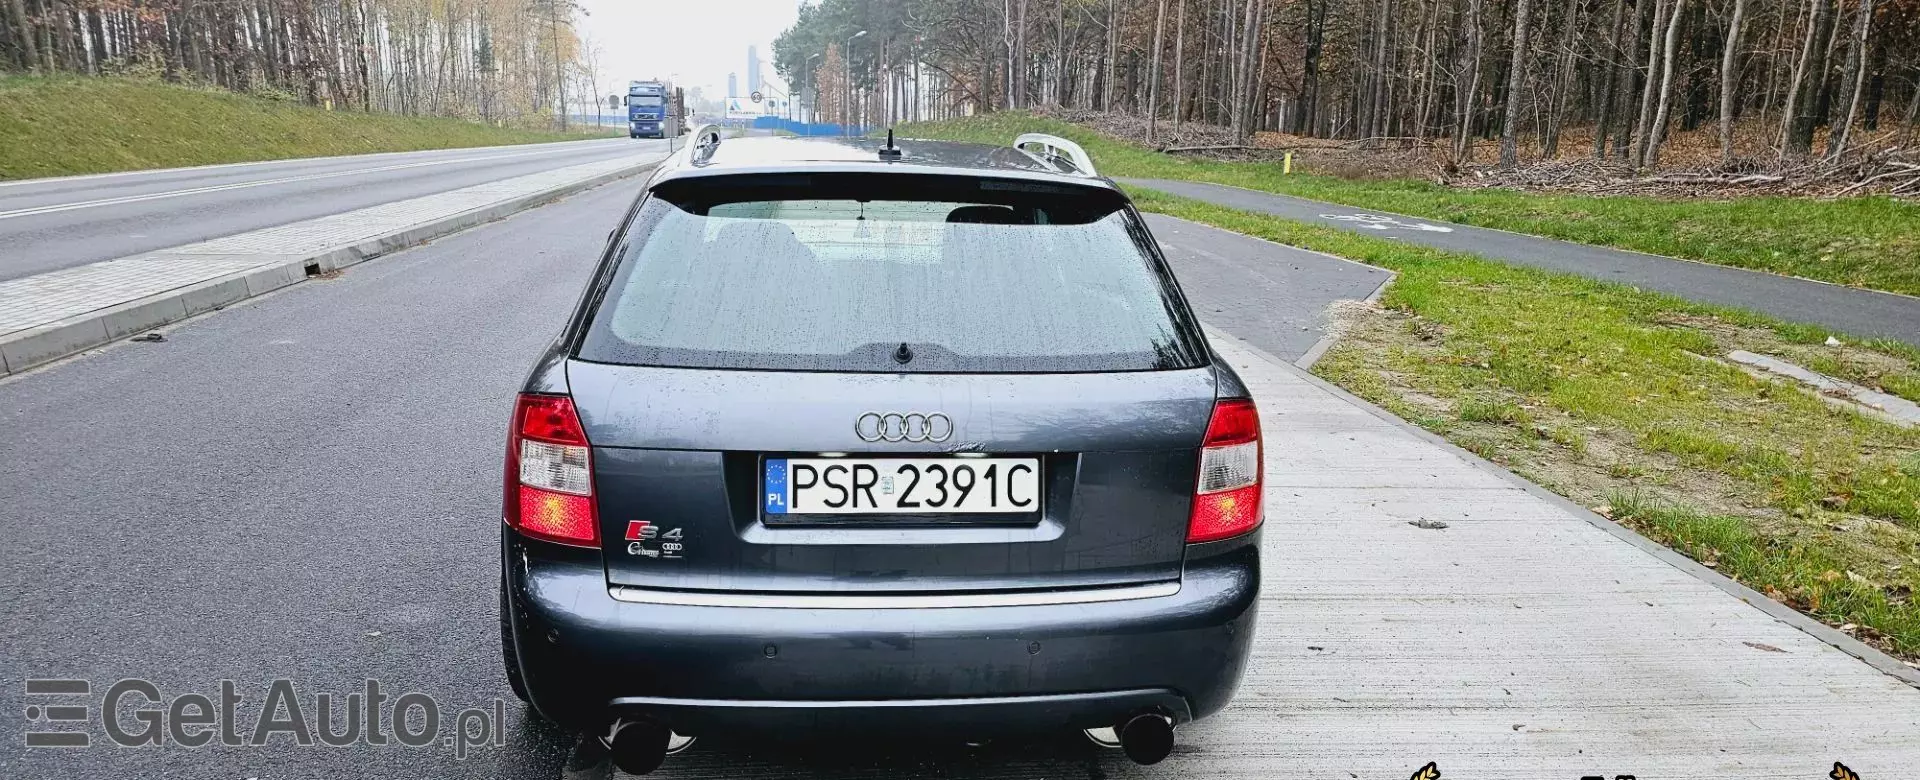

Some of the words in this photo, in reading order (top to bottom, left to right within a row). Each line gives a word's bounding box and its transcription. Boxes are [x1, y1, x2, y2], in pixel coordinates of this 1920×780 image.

[768, 493, 784, 506] PL
[791, 464, 879, 508] PSR
[896, 464, 1032, 508] 2391C
